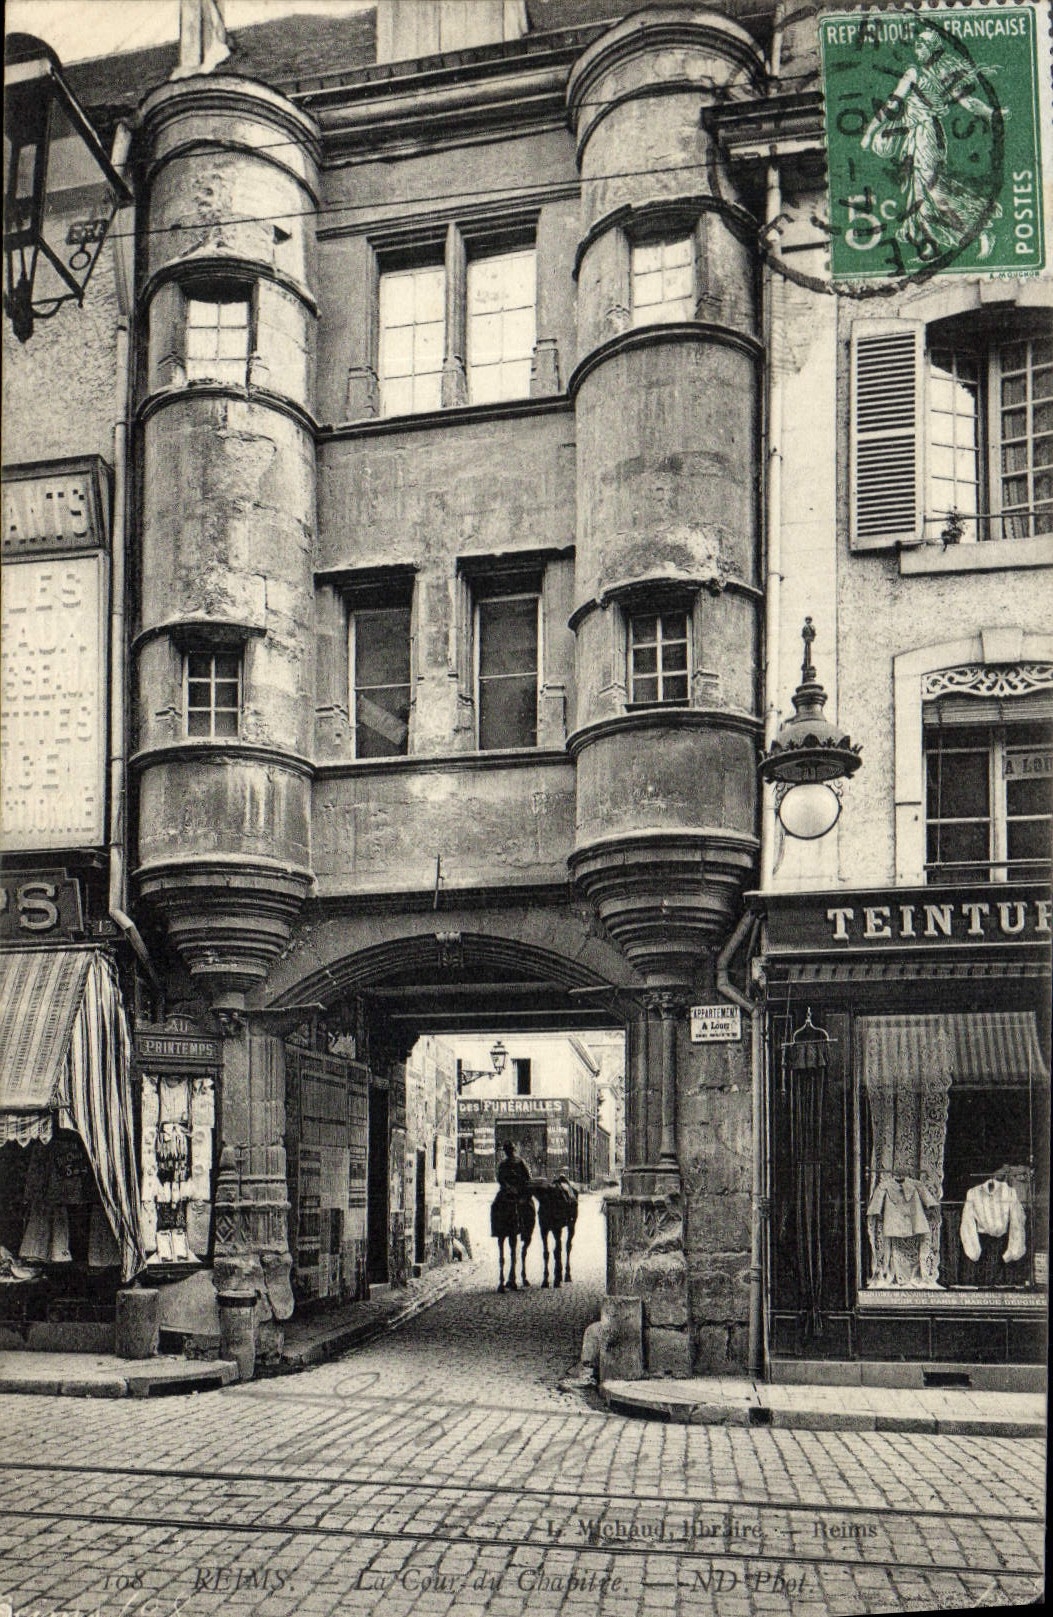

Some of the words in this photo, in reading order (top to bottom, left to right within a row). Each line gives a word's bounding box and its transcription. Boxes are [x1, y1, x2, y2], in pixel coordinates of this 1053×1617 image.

[943, 17, 1027, 42] FRANÇAISE
[1013, 170, 1034, 254] POSTES
[146, 1040, 214, 1056] PRINTEMPS
[459, 1103, 480, 1112] DES
